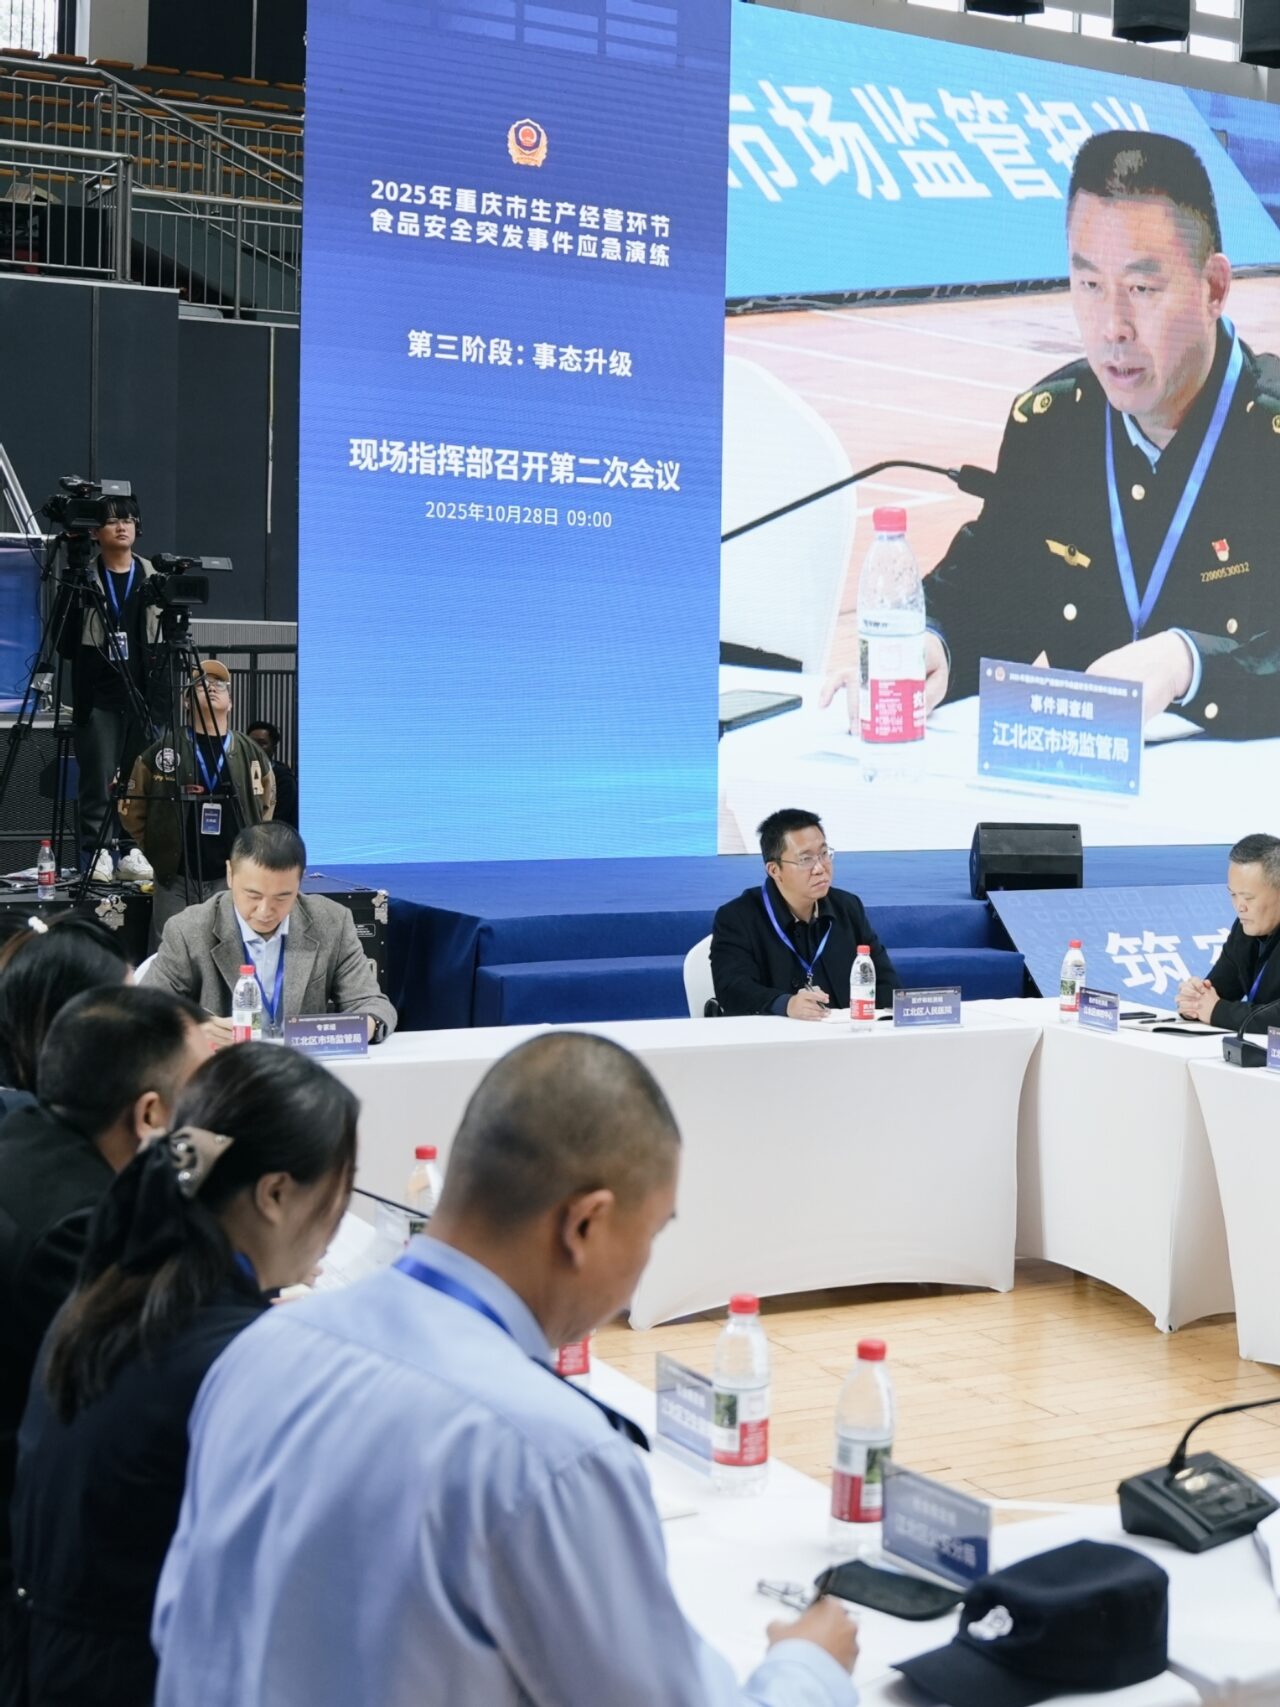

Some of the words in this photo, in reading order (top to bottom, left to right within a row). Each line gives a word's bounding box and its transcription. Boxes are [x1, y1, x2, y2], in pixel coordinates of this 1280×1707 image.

[370, 179, 671, 238] 2025年重庆市生产经营环节
[370, 208, 670, 268] 食品安全突发事件应急演练
[407, 330, 633, 378] 第三阶段：事态升级
[348, 438, 681, 491] 现场指挥部召开第二次会议
[425, 501, 559, 527] 2025年10月28日
[566, 510, 613, 528] 09:00
[992, 719, 1129, 763] 江北区市场监管局
